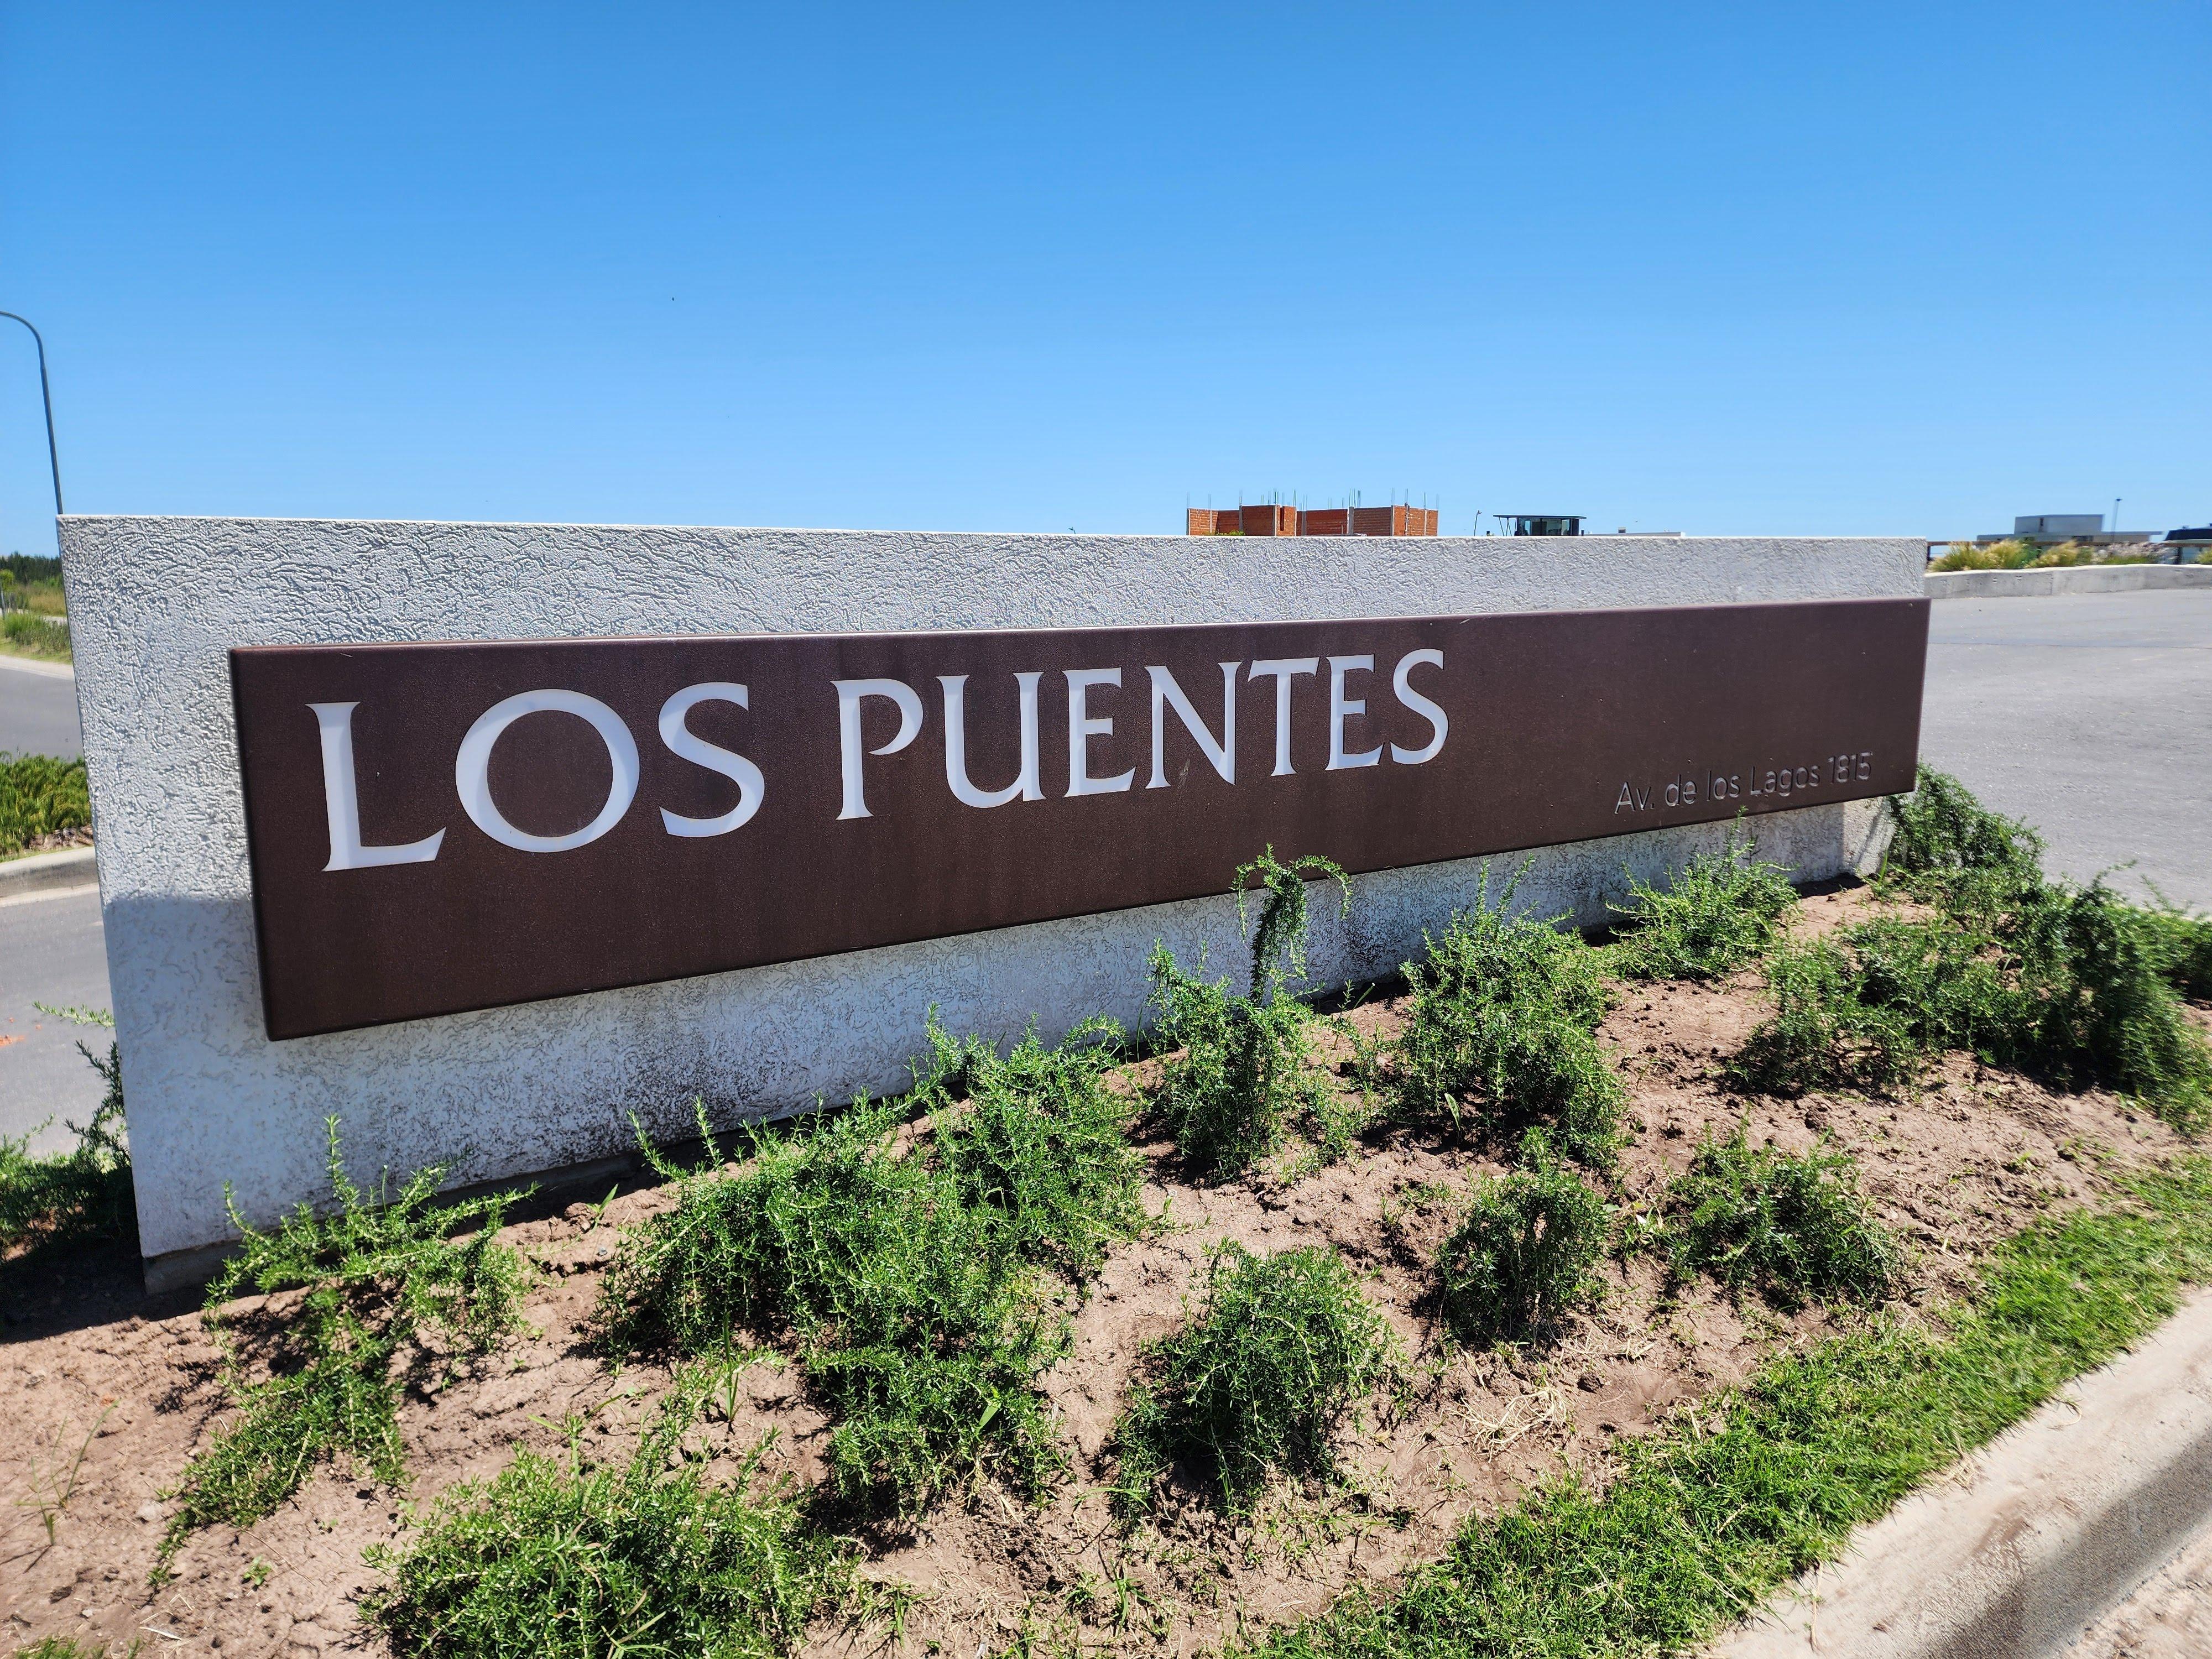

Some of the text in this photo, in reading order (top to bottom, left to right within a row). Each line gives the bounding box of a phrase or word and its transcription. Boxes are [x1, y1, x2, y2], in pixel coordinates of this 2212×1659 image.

[306, 648, 1449, 872] LOS PUENTES
[1614, 752, 1874, 815] Av. de los Lagos 1815
